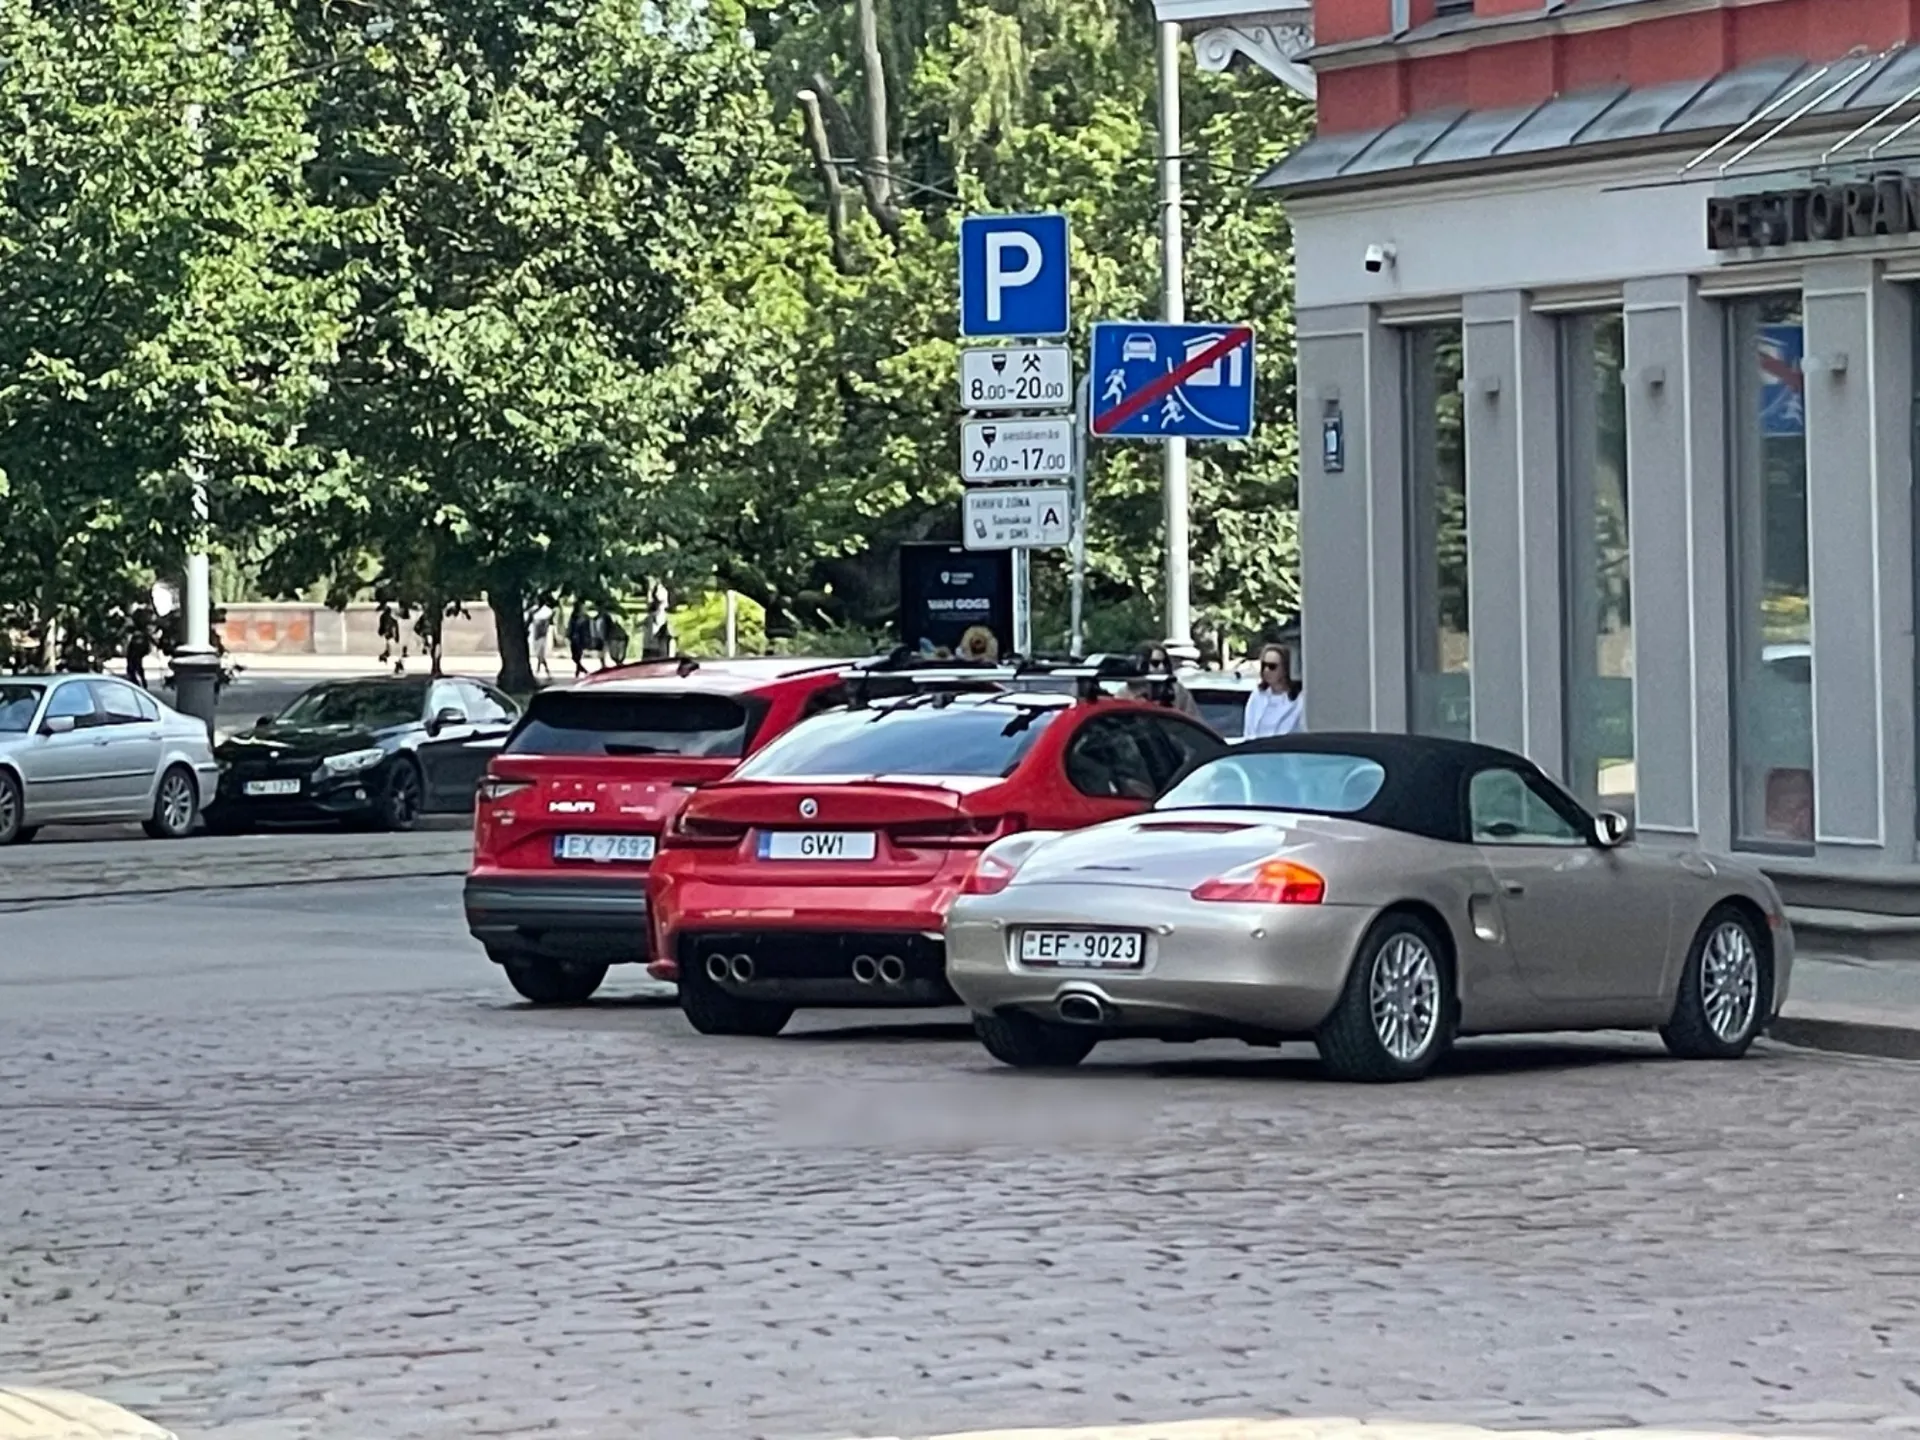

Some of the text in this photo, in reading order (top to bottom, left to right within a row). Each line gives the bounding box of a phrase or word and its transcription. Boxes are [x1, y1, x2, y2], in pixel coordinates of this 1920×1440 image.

[986, 231, 1043, 321] P
[971, 376, 1064, 400] 8.00-20.00
[972, 448, 1066, 472] 9.00-17.00
[1043, 508, 1060, 526] A
[568, 837, 652, 857] EX-7692
[801, 835, 844, 855] GW1
[1038, 934, 1136, 958] EF-9023
